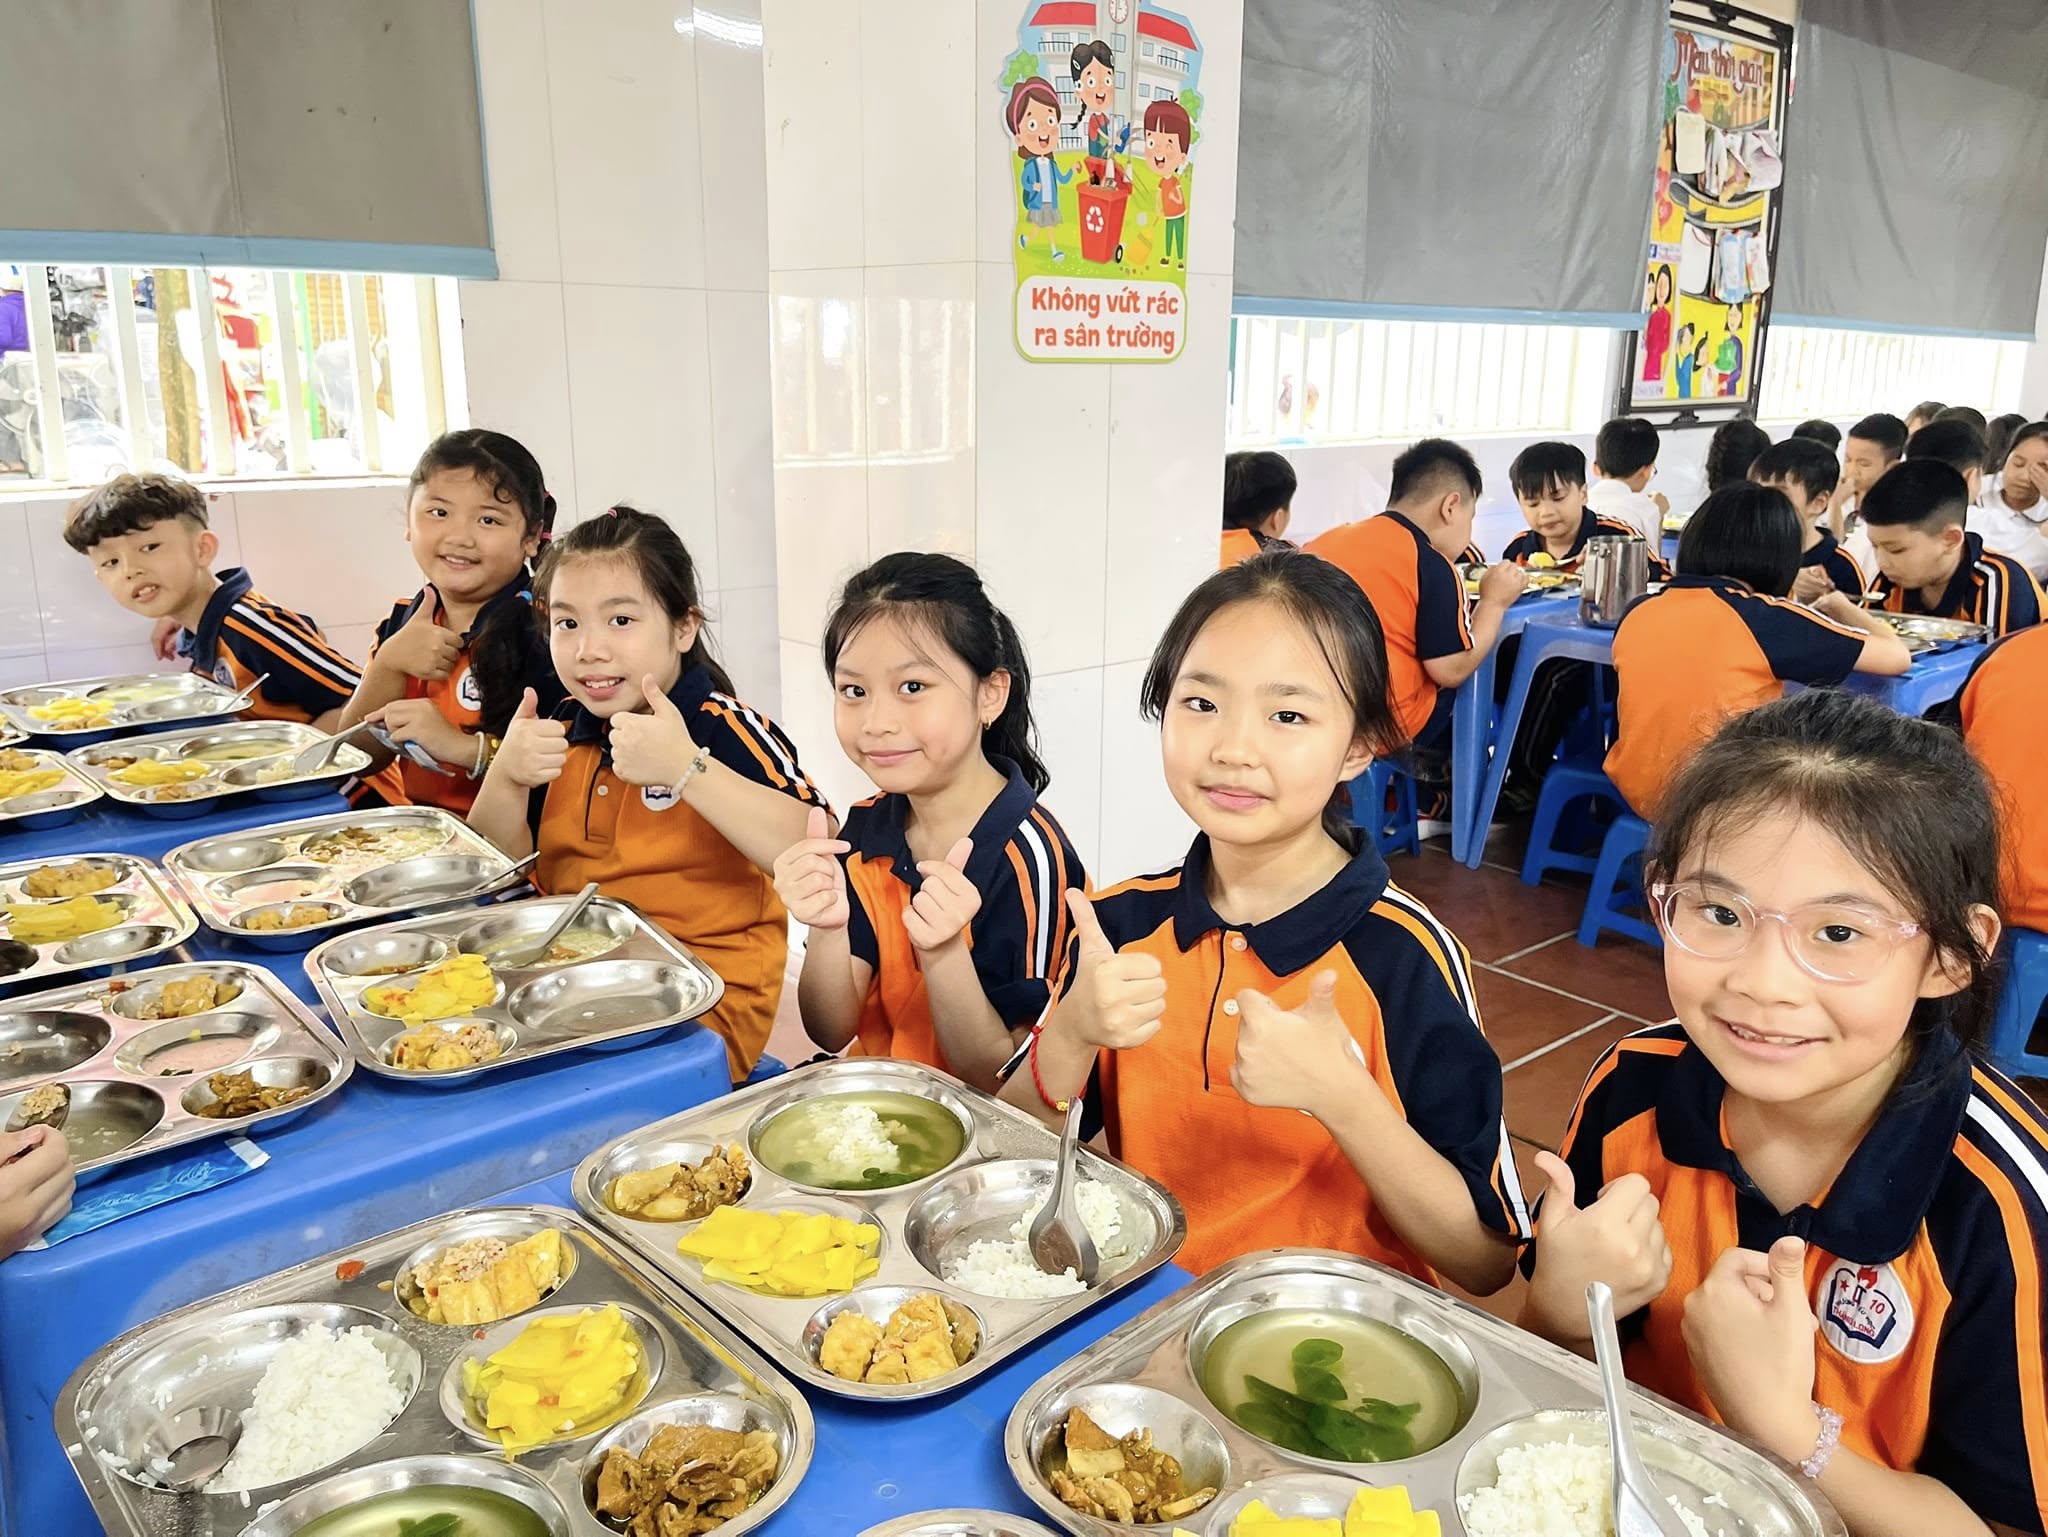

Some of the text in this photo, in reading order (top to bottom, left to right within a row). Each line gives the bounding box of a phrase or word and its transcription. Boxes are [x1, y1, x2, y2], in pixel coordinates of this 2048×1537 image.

[1032, 286, 1178, 319] Không vứt rác
[1035, 321, 1175, 355] ra sân trường
[1869, 1299, 1886, 1315] 10
